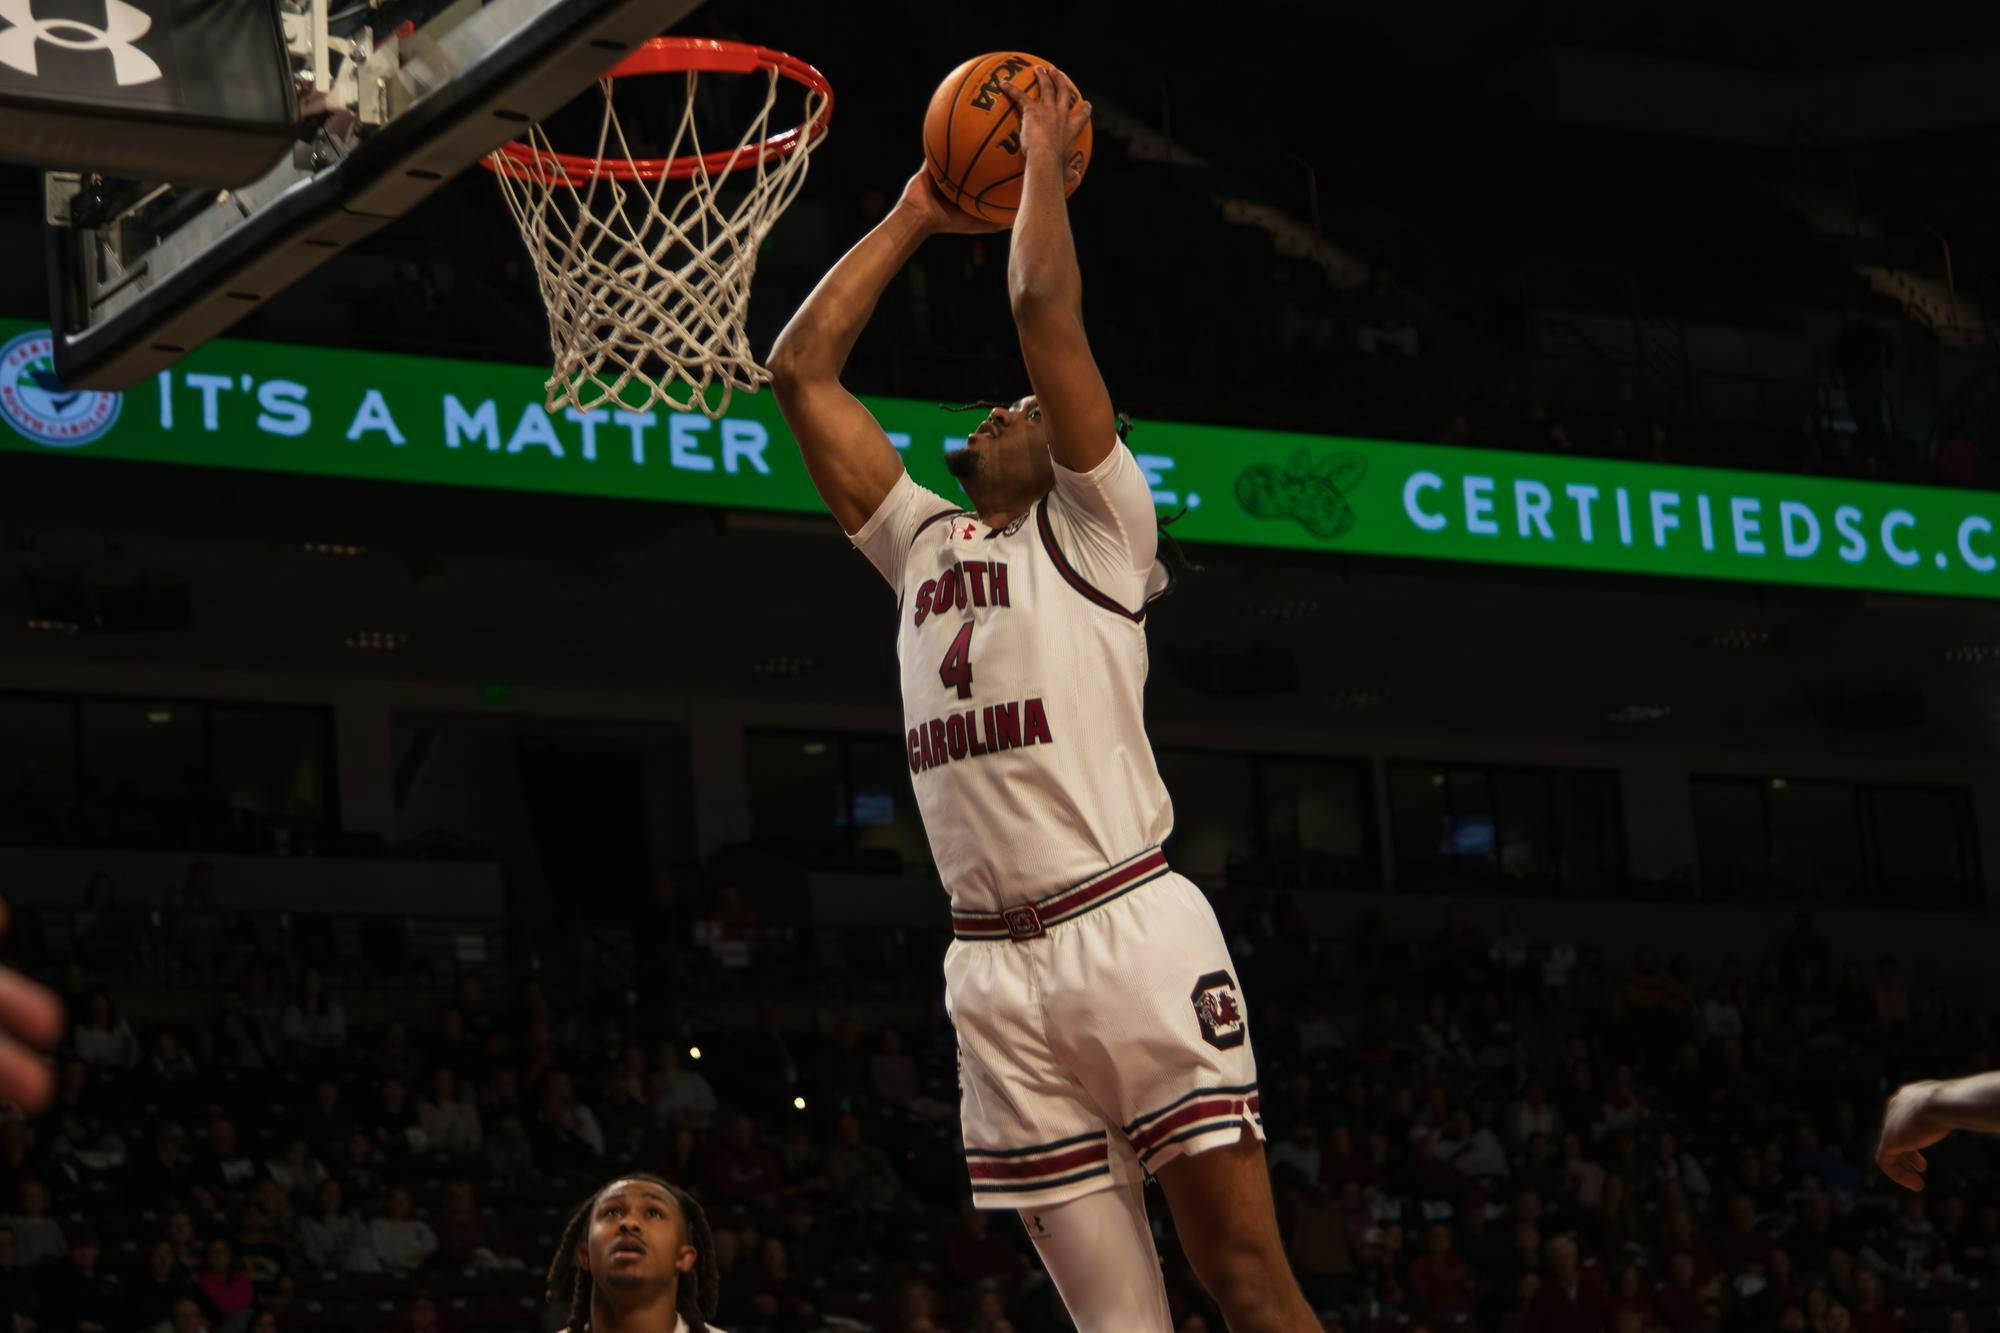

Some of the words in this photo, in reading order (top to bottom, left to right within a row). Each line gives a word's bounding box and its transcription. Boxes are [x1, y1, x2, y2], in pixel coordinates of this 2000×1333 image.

[971, 56, 1032, 111] NCAA
[157, 369, 312, 438] IT'S
[346, 388, 407, 447] A
[443, 395, 772, 475] MATTER
[1402, 470, 1997, 572] CERTIFIEDSC.C
[914, 560, 1011, 628] SOUTH
[938, 620, 974, 700] 4
[906, 697, 1054, 775] CAROLINA
